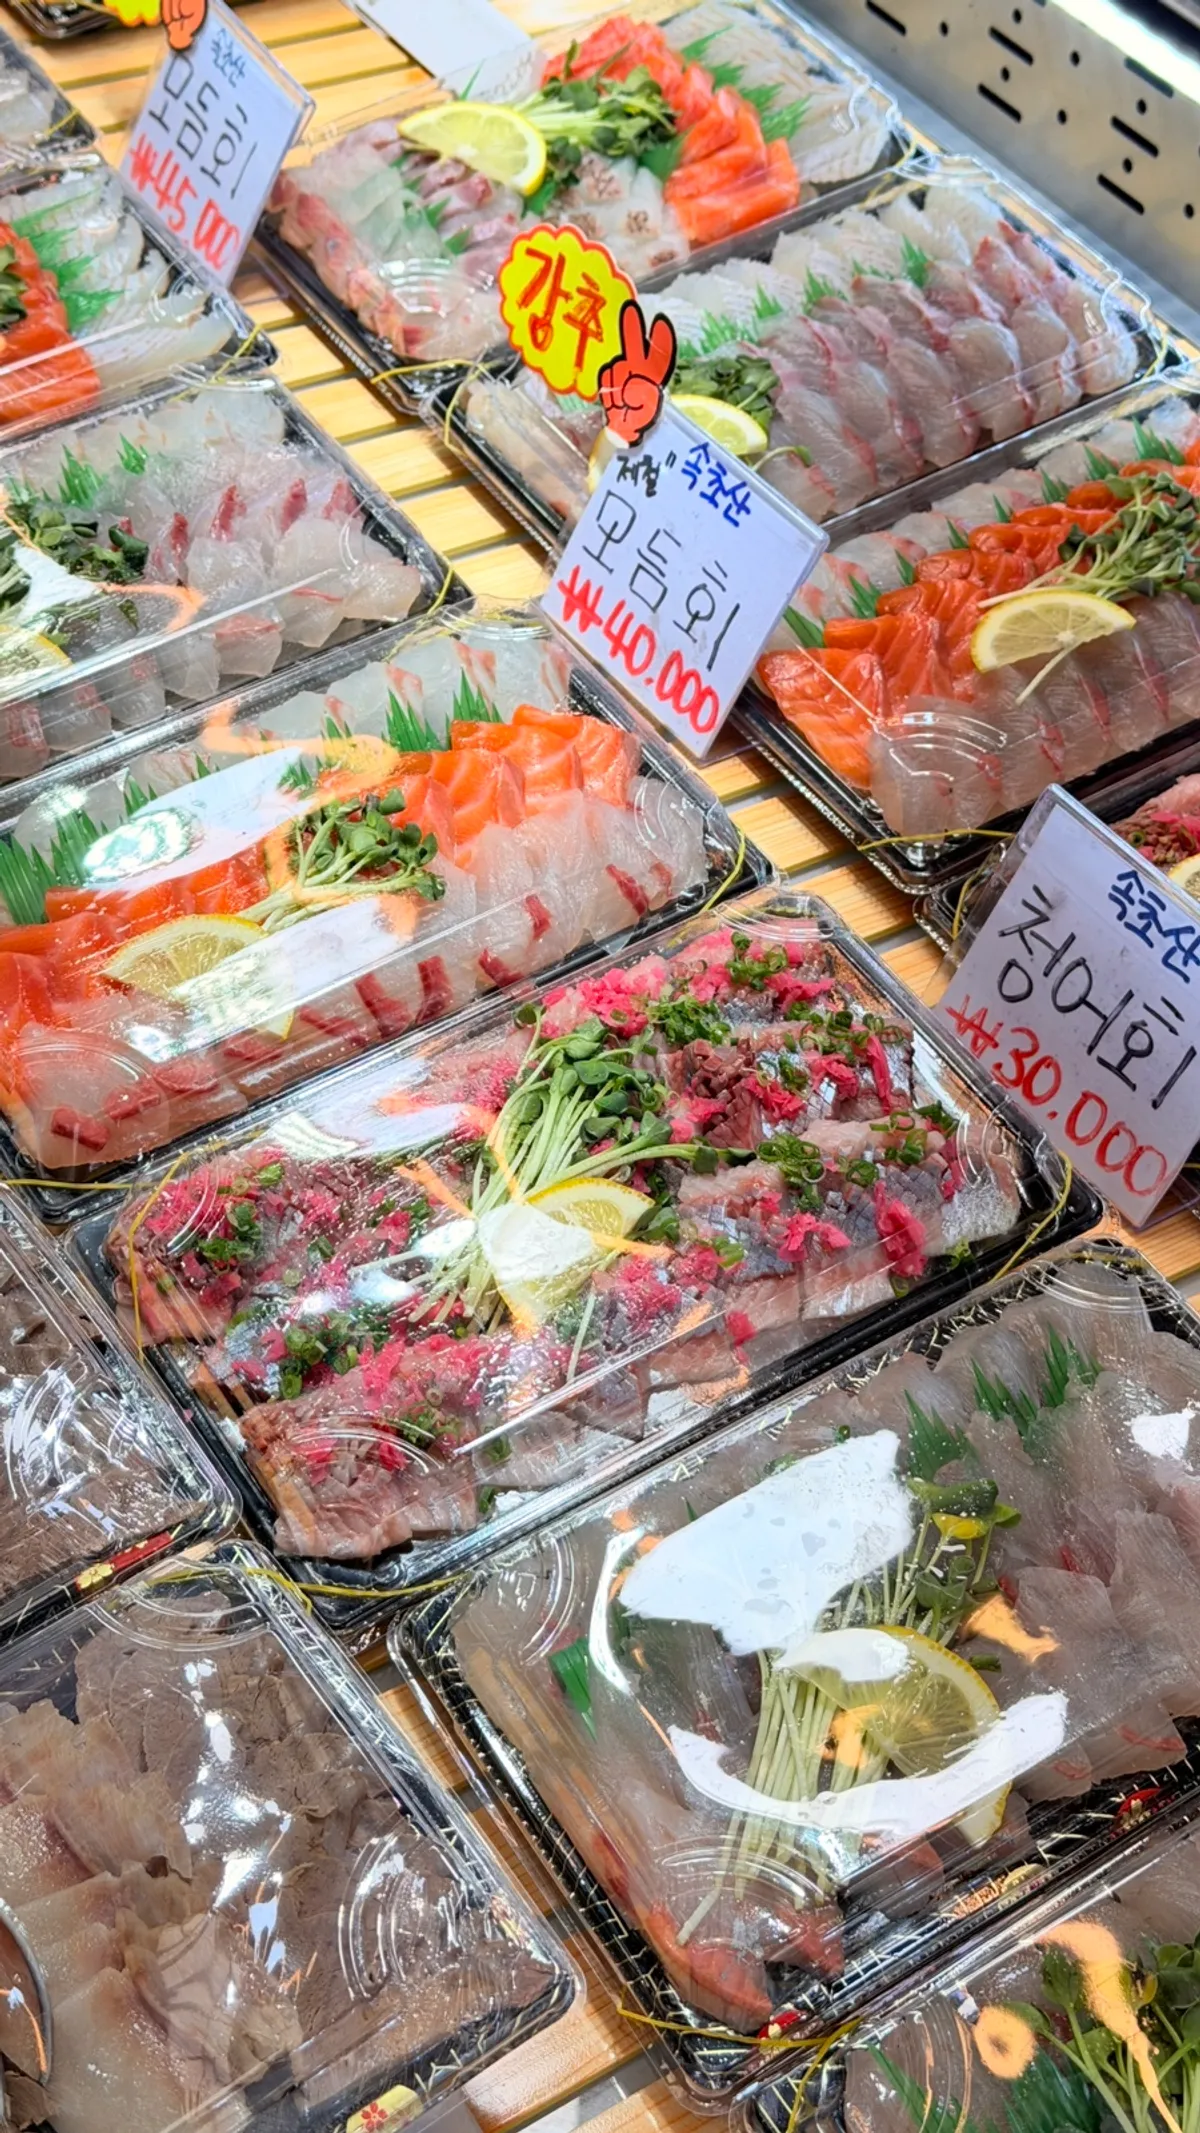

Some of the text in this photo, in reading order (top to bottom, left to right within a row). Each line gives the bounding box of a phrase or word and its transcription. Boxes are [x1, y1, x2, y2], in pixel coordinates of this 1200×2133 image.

[148, 53, 257, 199] 모듬회
[516, 247, 607, 372] 강추
[681, 442, 751, 527] 속초산
[557, 565, 719, 733] ₩40.000
[582, 490, 740, 672] 모듬회
[998, 884, 1197, 1110] 청어회
[1108, 870, 1200, 984] 속초산
[945, 995, 1168, 1197] ₩30.000
